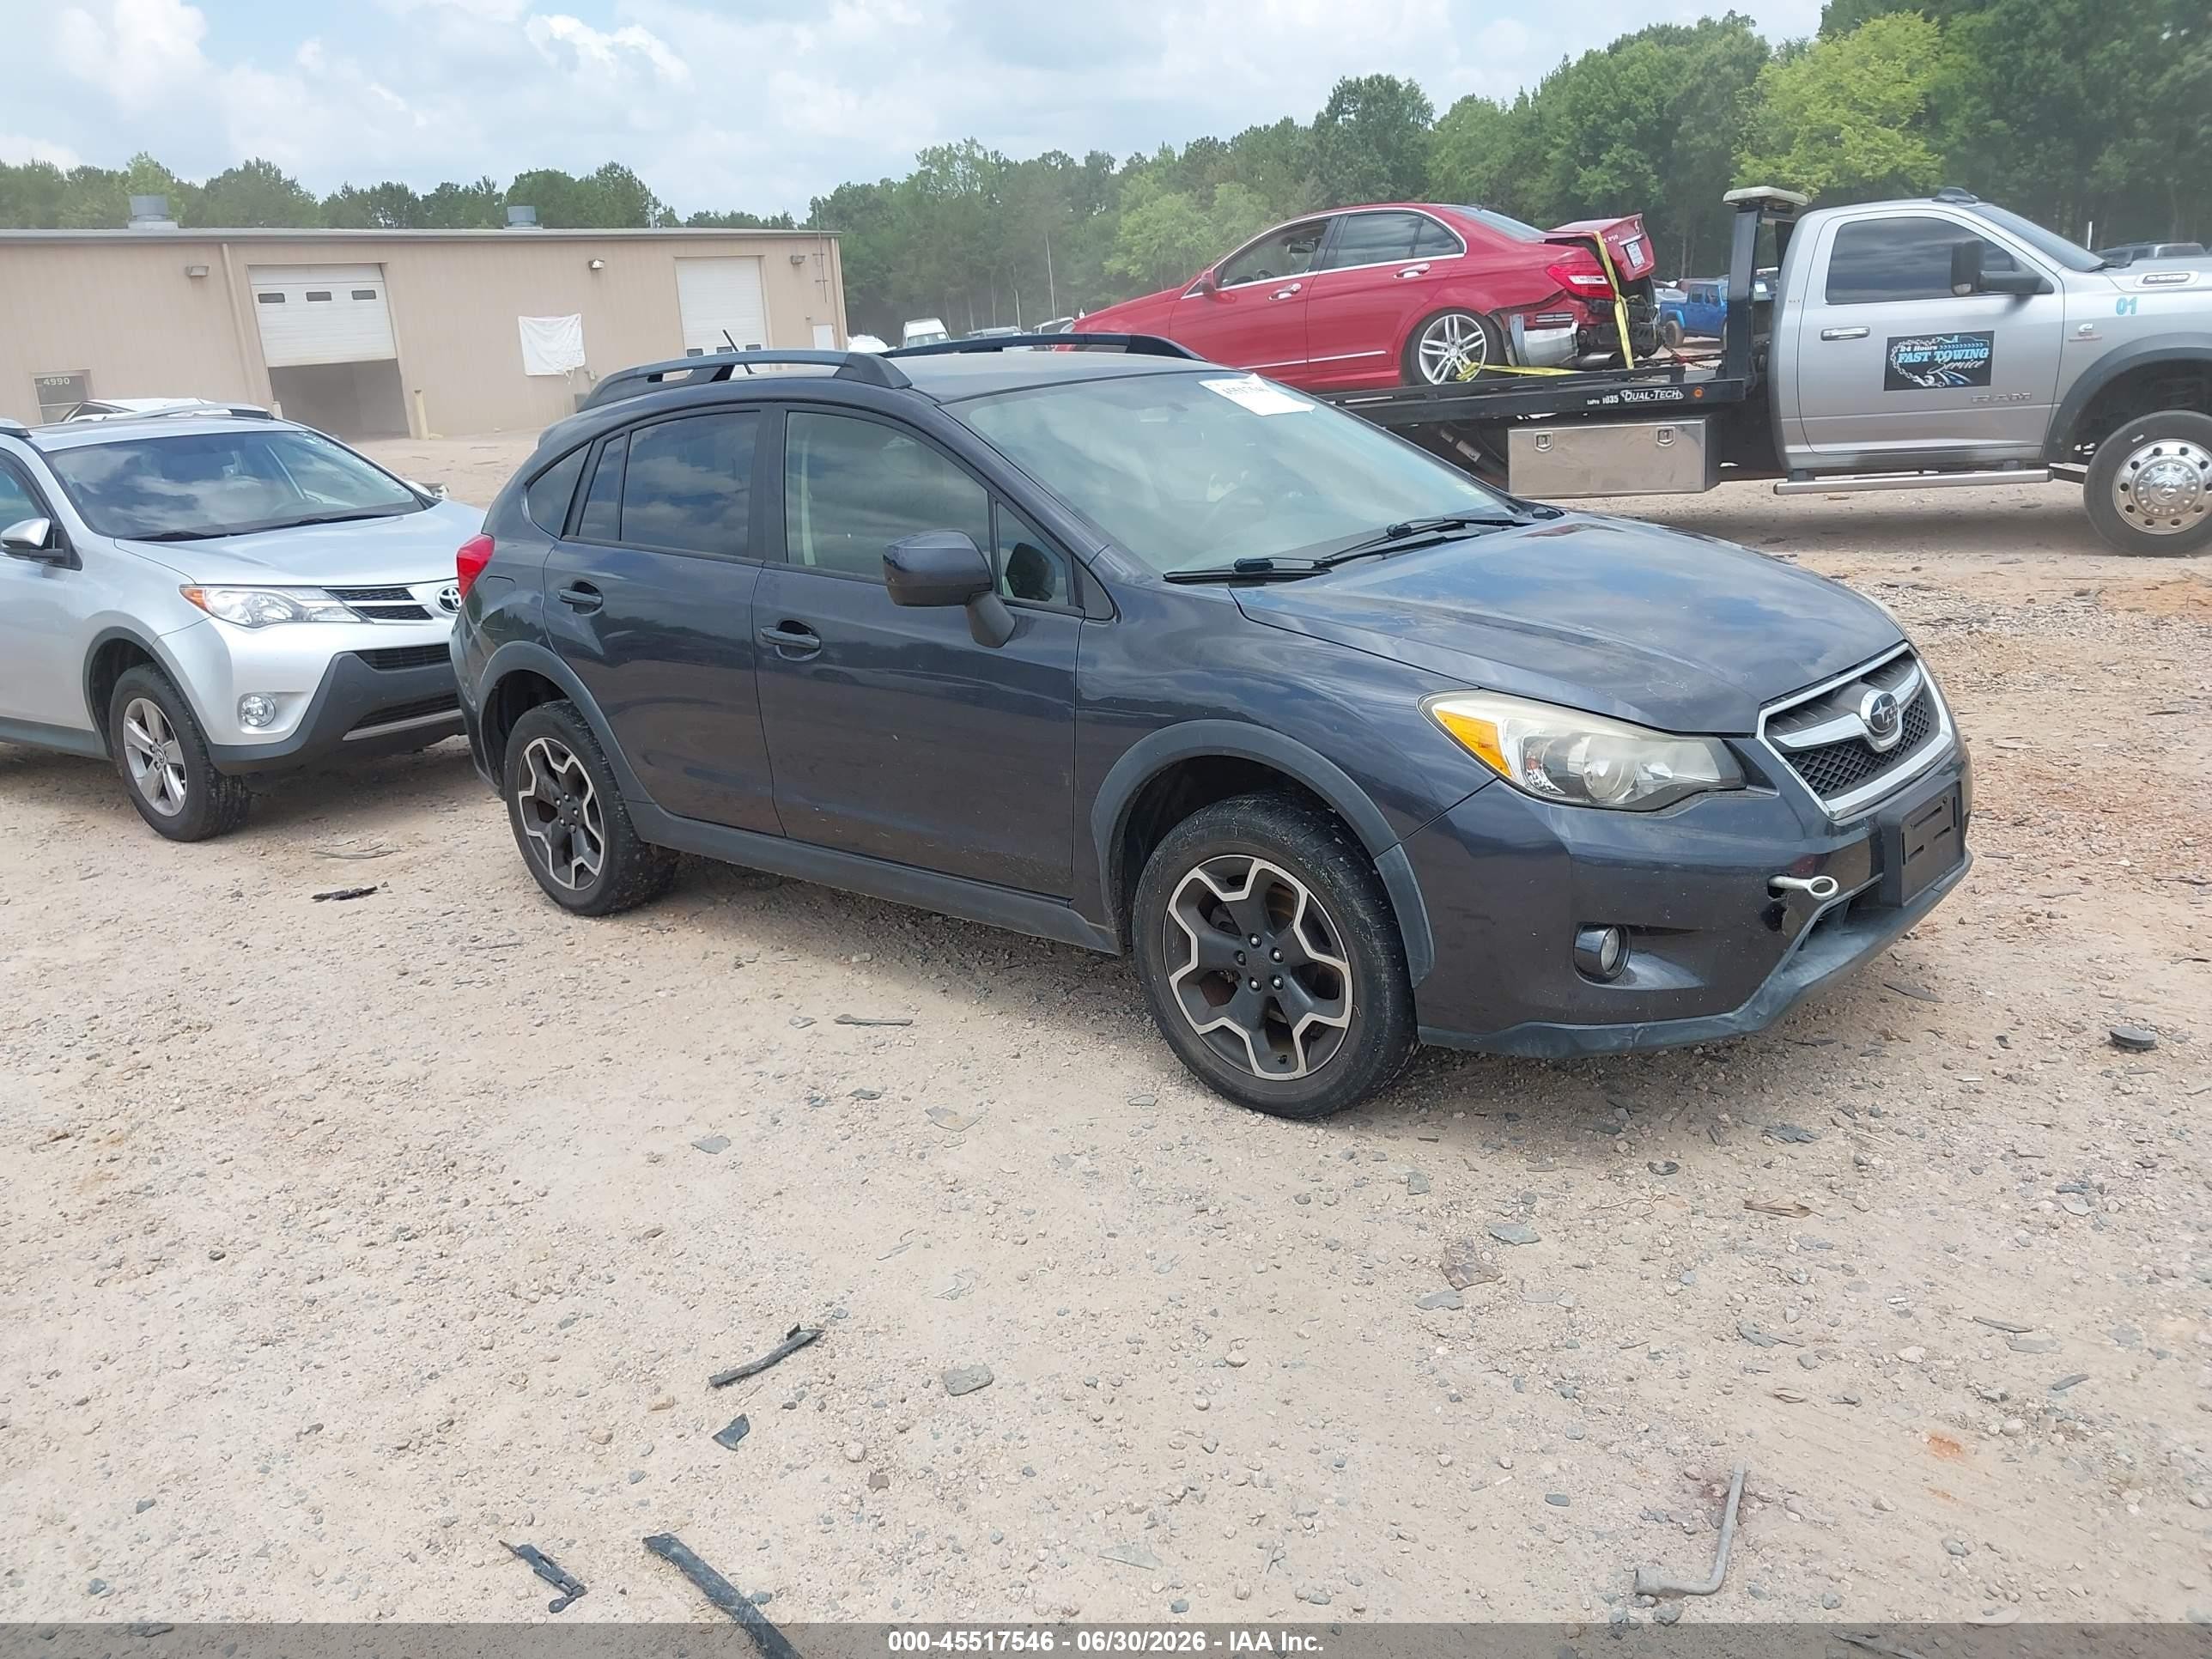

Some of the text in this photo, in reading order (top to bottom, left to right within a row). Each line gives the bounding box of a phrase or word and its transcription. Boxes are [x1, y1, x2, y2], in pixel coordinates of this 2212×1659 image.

[2116, 296, 2137, 316] 01
[1898, 348, 1990, 363] FAST TOWING
[1927, 357, 1985, 374] Service
[1972, 392, 2032, 404] RAM
